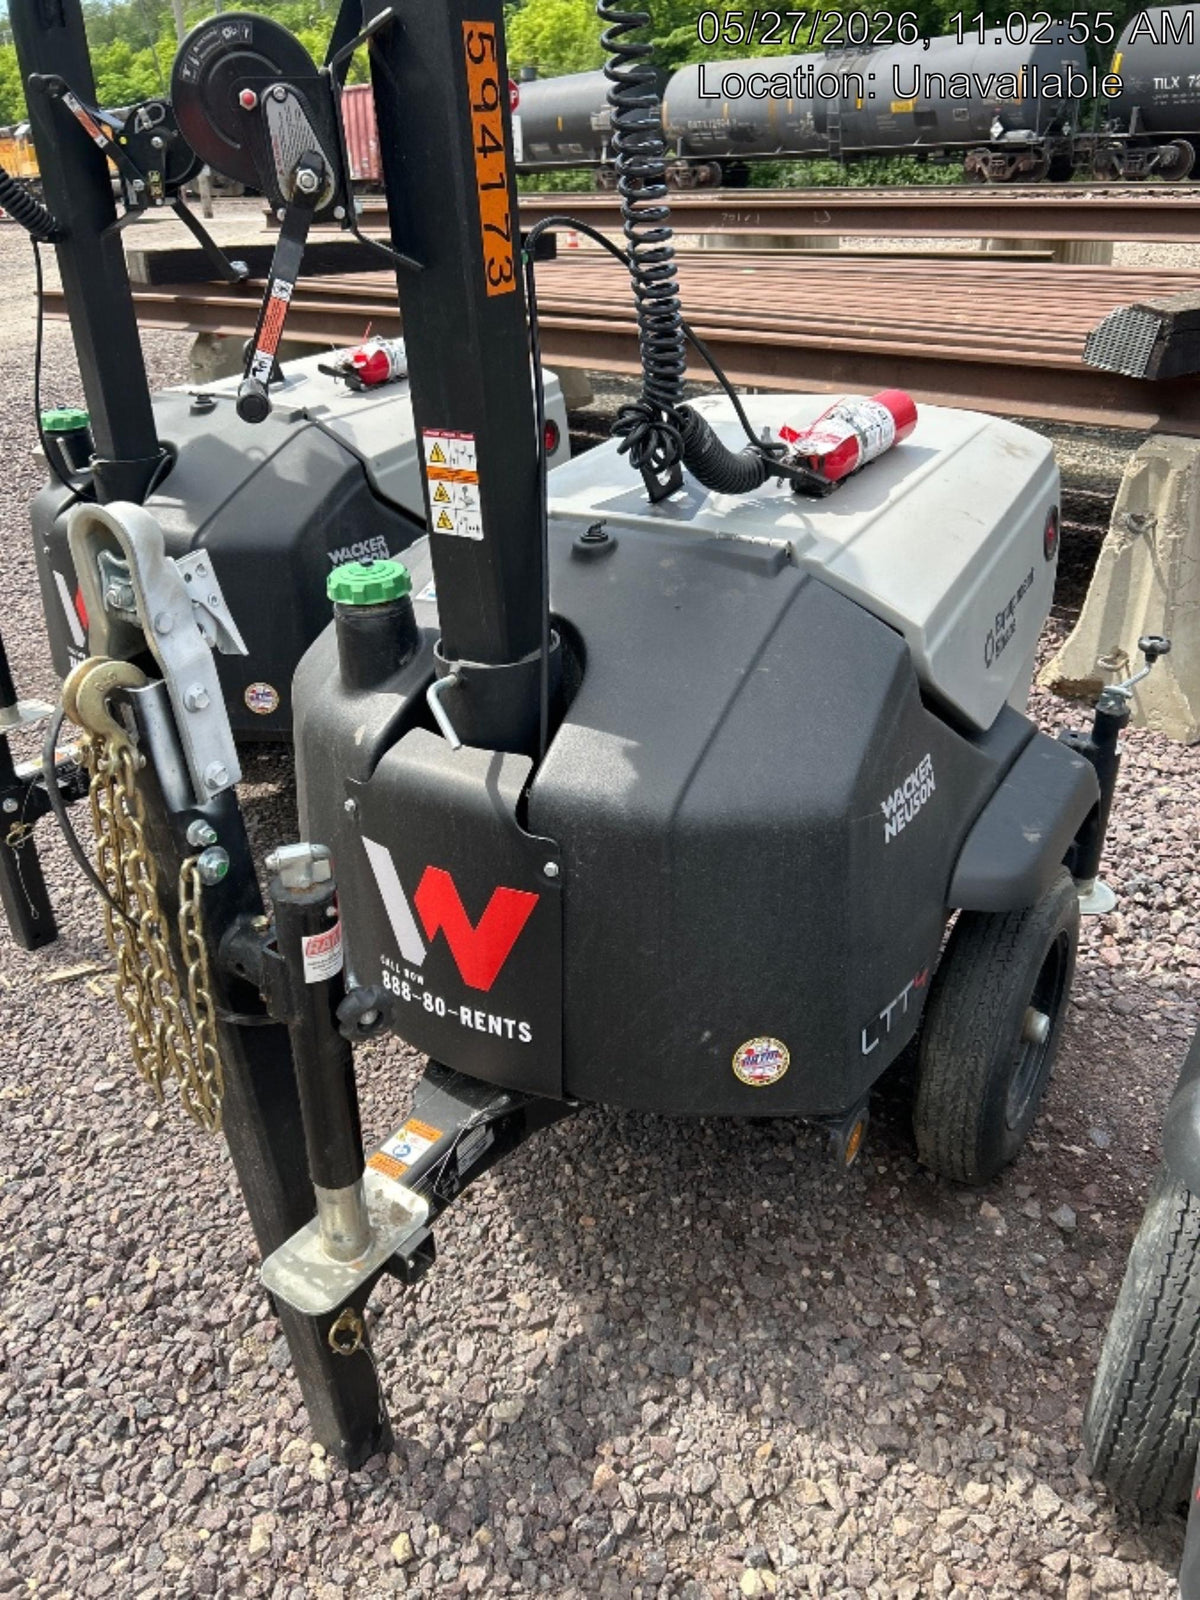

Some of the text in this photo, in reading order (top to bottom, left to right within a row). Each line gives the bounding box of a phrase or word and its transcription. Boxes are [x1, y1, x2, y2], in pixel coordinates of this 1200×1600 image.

[1152, 76, 1180, 90] TILX
[466, 29, 513, 287] 594173
[326, 534, 388, 564] WACKER
[880, 753, 932, 819] WACKER
[884, 771, 936, 844] NEUSON
[381, 969, 533, 1043] 888-80-RENTS
